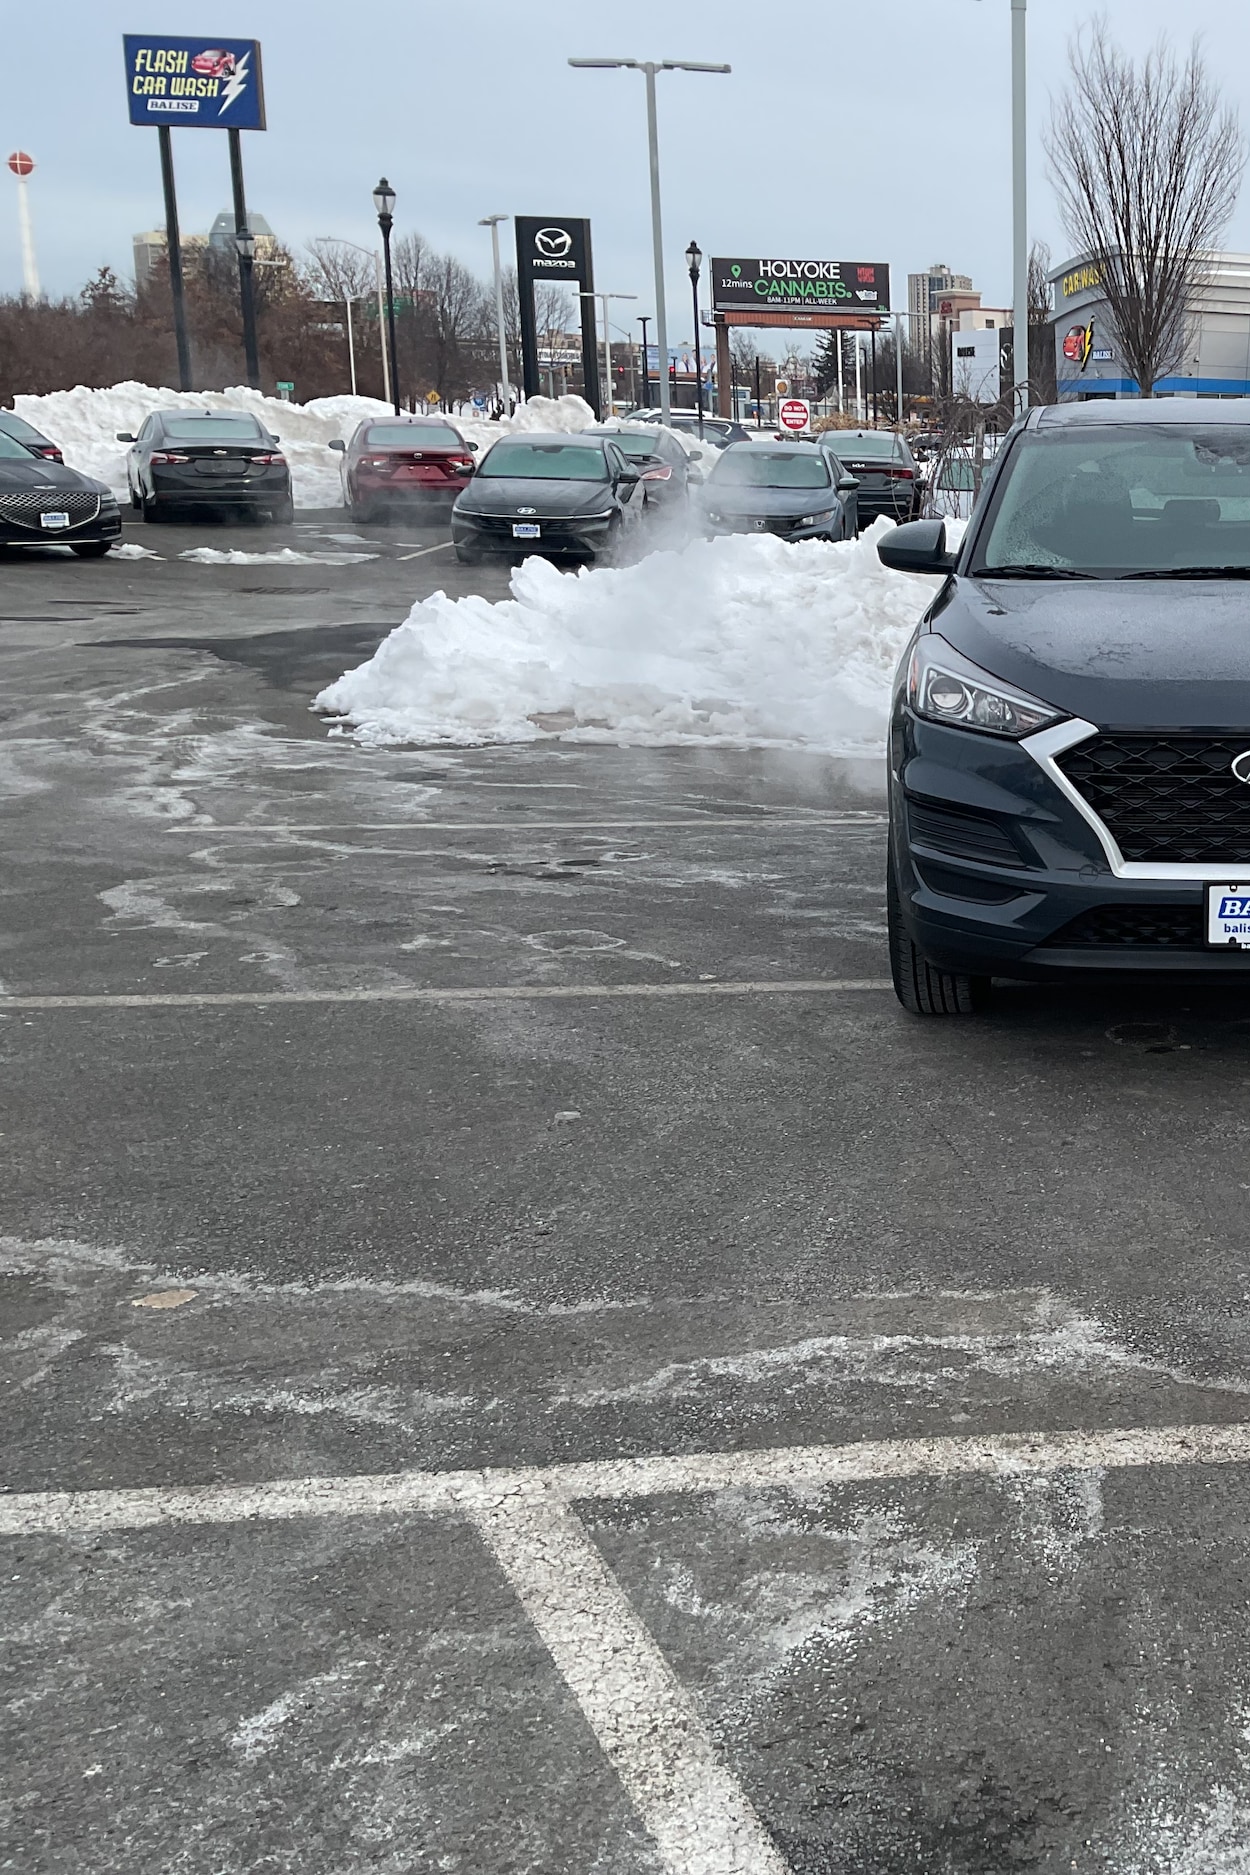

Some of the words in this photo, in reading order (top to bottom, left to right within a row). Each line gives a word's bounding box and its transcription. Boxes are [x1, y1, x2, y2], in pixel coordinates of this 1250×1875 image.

[135, 49, 188, 73] FLASH
[132, 76, 166, 95] CAR
[170, 77, 219, 97] WASH
[150, 101, 197, 110] BALISE
[532, 259, 576, 269] mazda
[759, 260, 840, 279] HOLYOKE
[721, 279, 753, 289] 12mins
[1063, 273, 1080, 297] CAR
